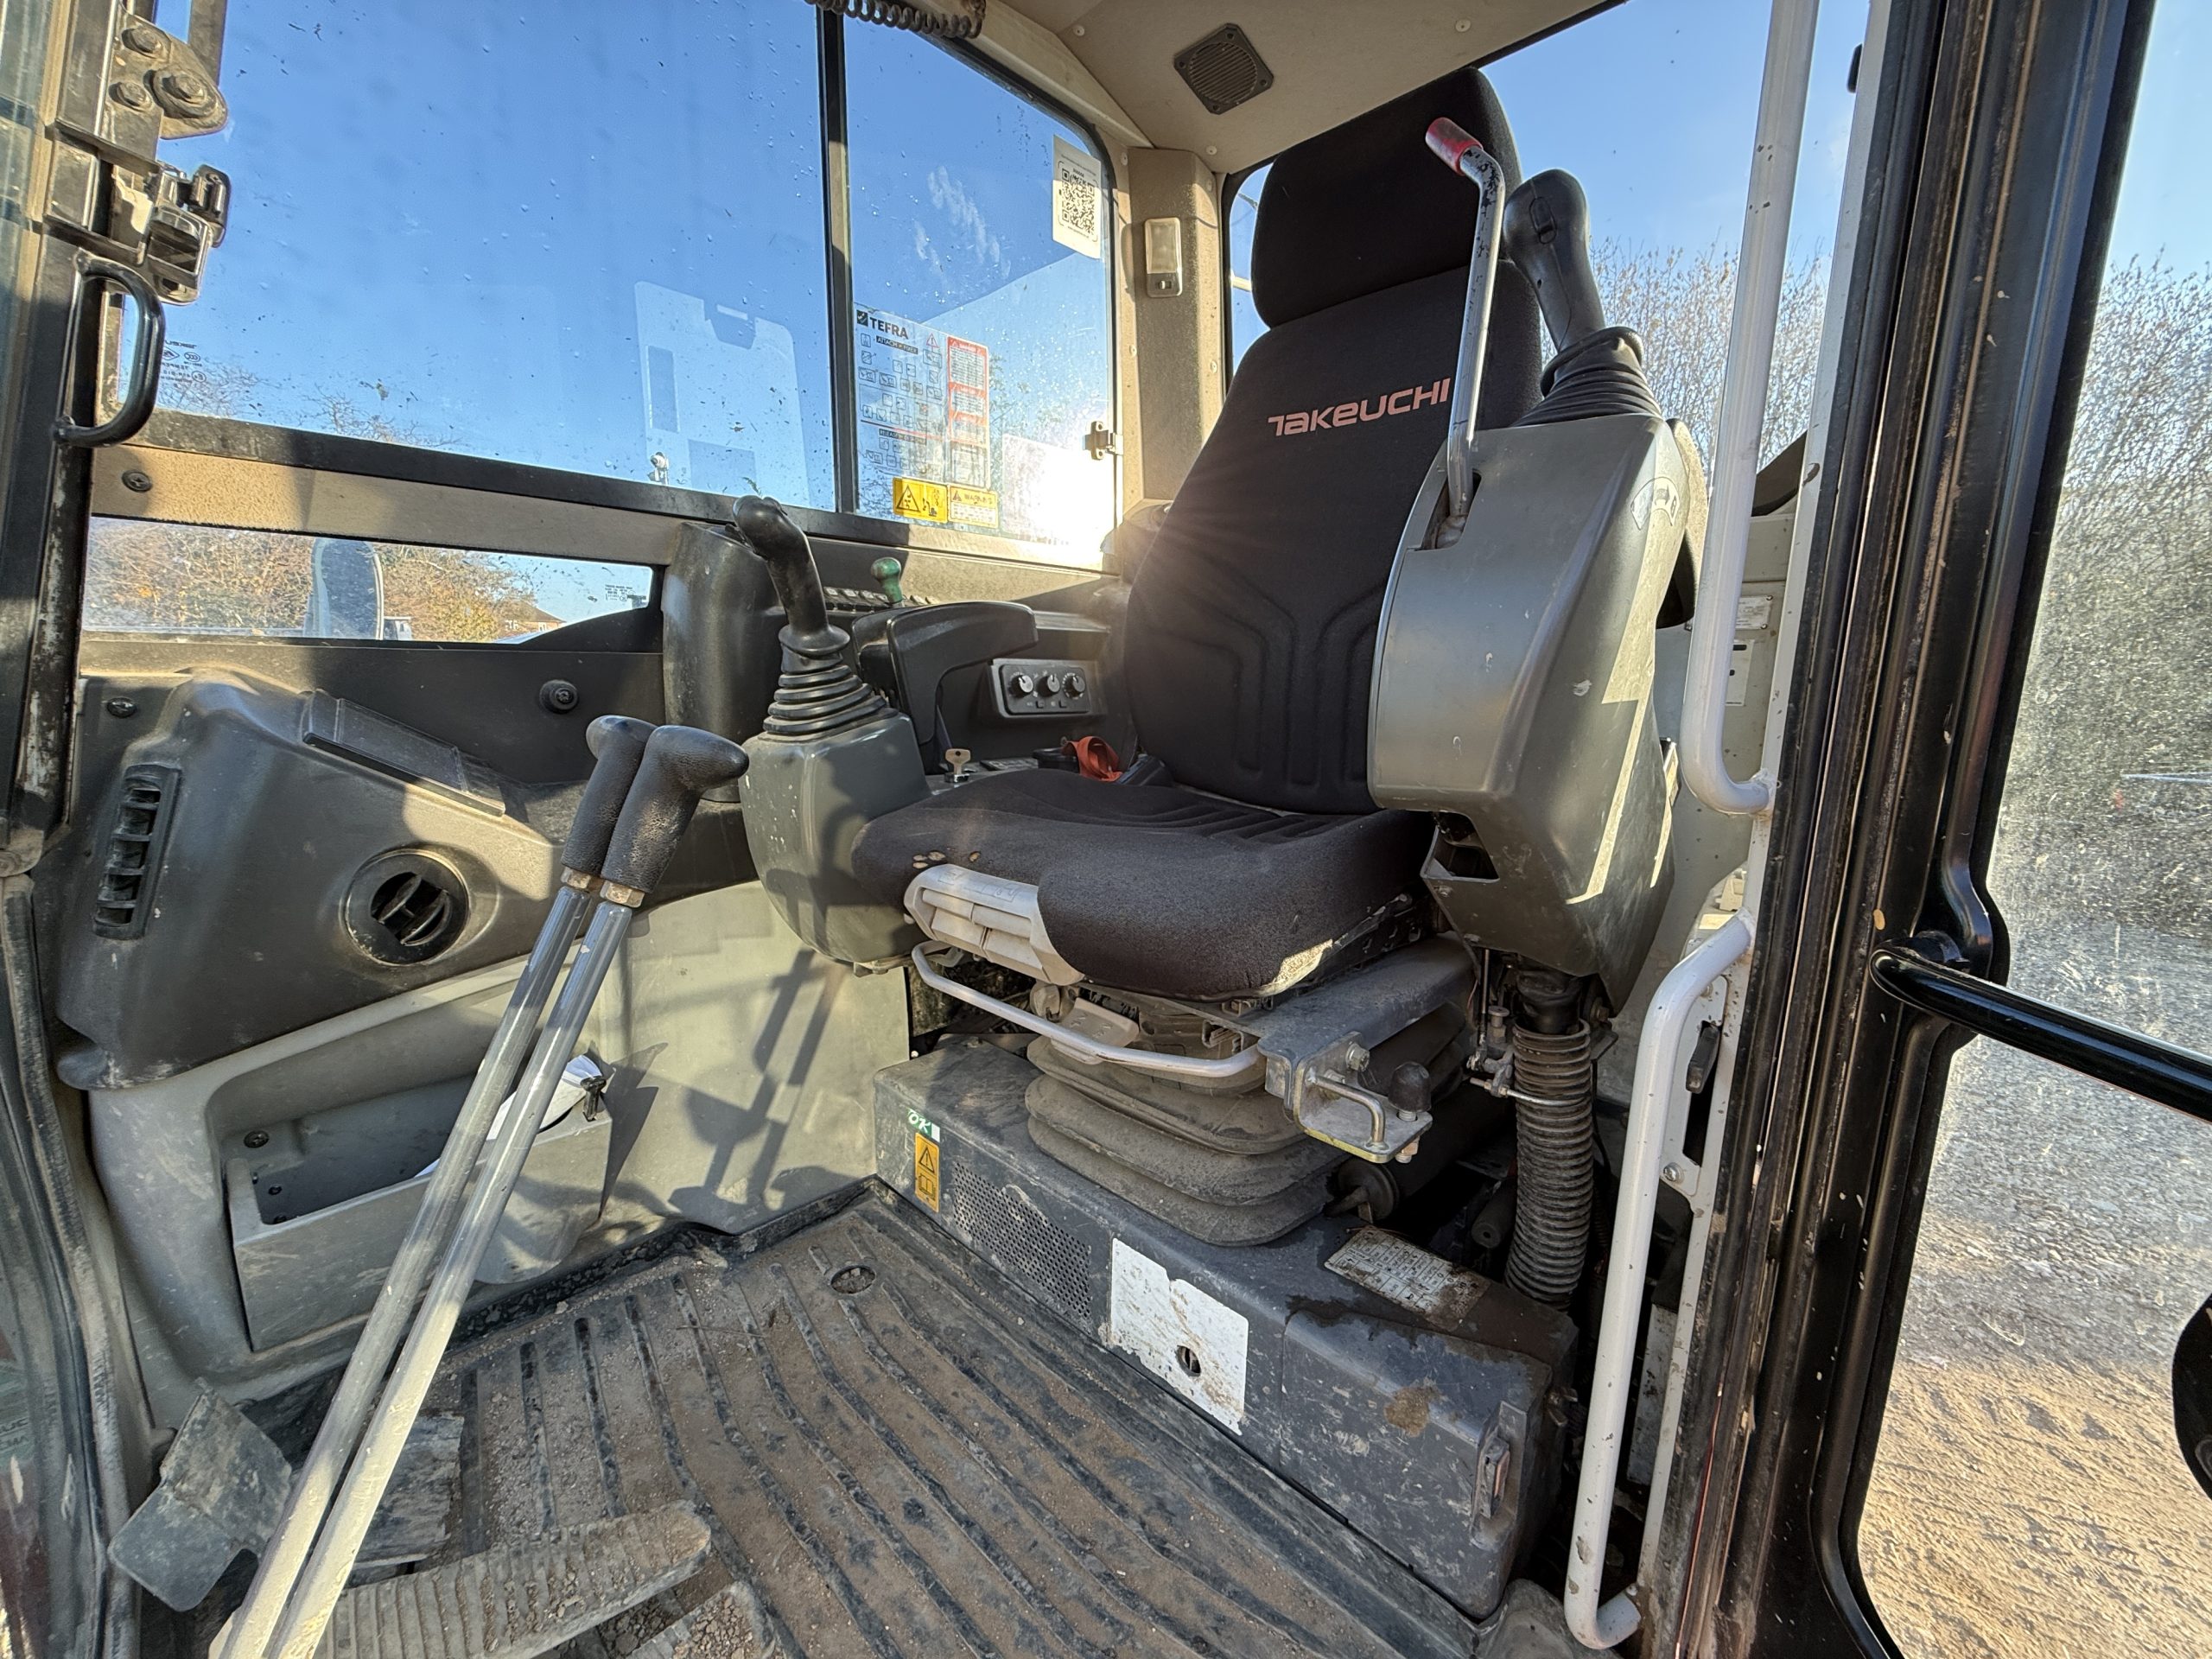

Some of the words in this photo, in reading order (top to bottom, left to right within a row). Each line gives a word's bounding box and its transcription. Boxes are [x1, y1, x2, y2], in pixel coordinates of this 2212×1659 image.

[870, 317, 908, 340] TEFRA
[1268, 378, 1451, 436] TAKEUCHI
[908, 1113, 931, 1134] OK
